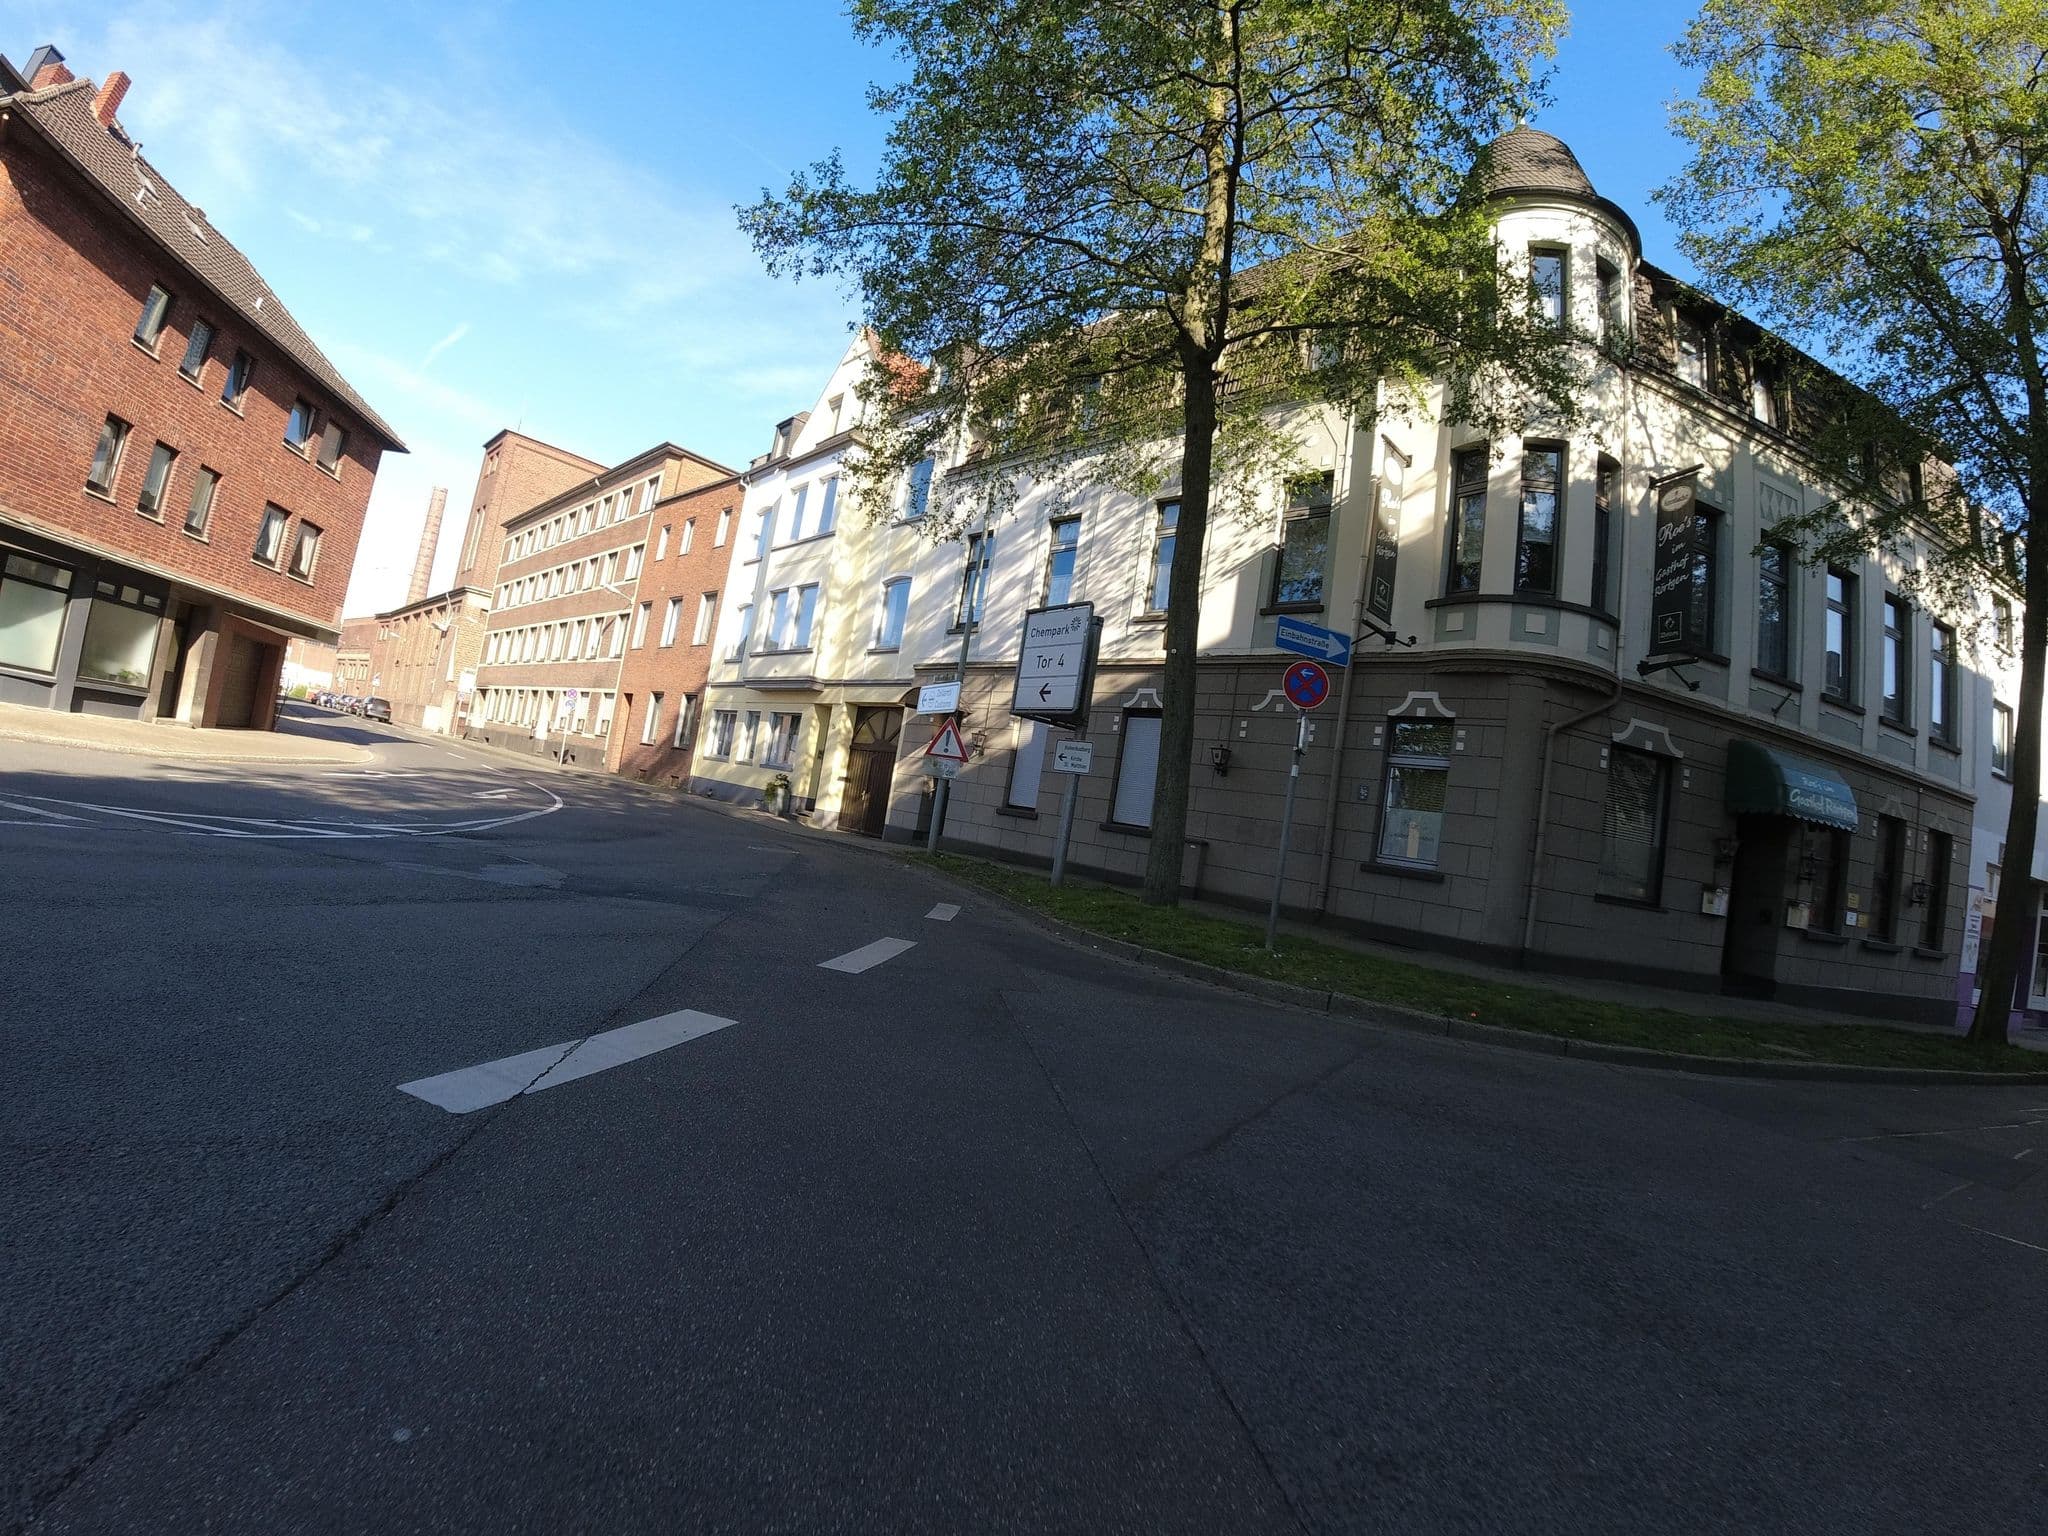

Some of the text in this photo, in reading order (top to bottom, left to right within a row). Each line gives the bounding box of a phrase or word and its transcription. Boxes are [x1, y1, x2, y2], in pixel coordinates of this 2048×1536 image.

[1655, 553, 1690, 582] Gasthof
[1030, 624, 1070, 639] Chempark
[1280, 628, 1330, 650] Einbahnstraße
[1036, 653, 1065, 669] Tor 4
